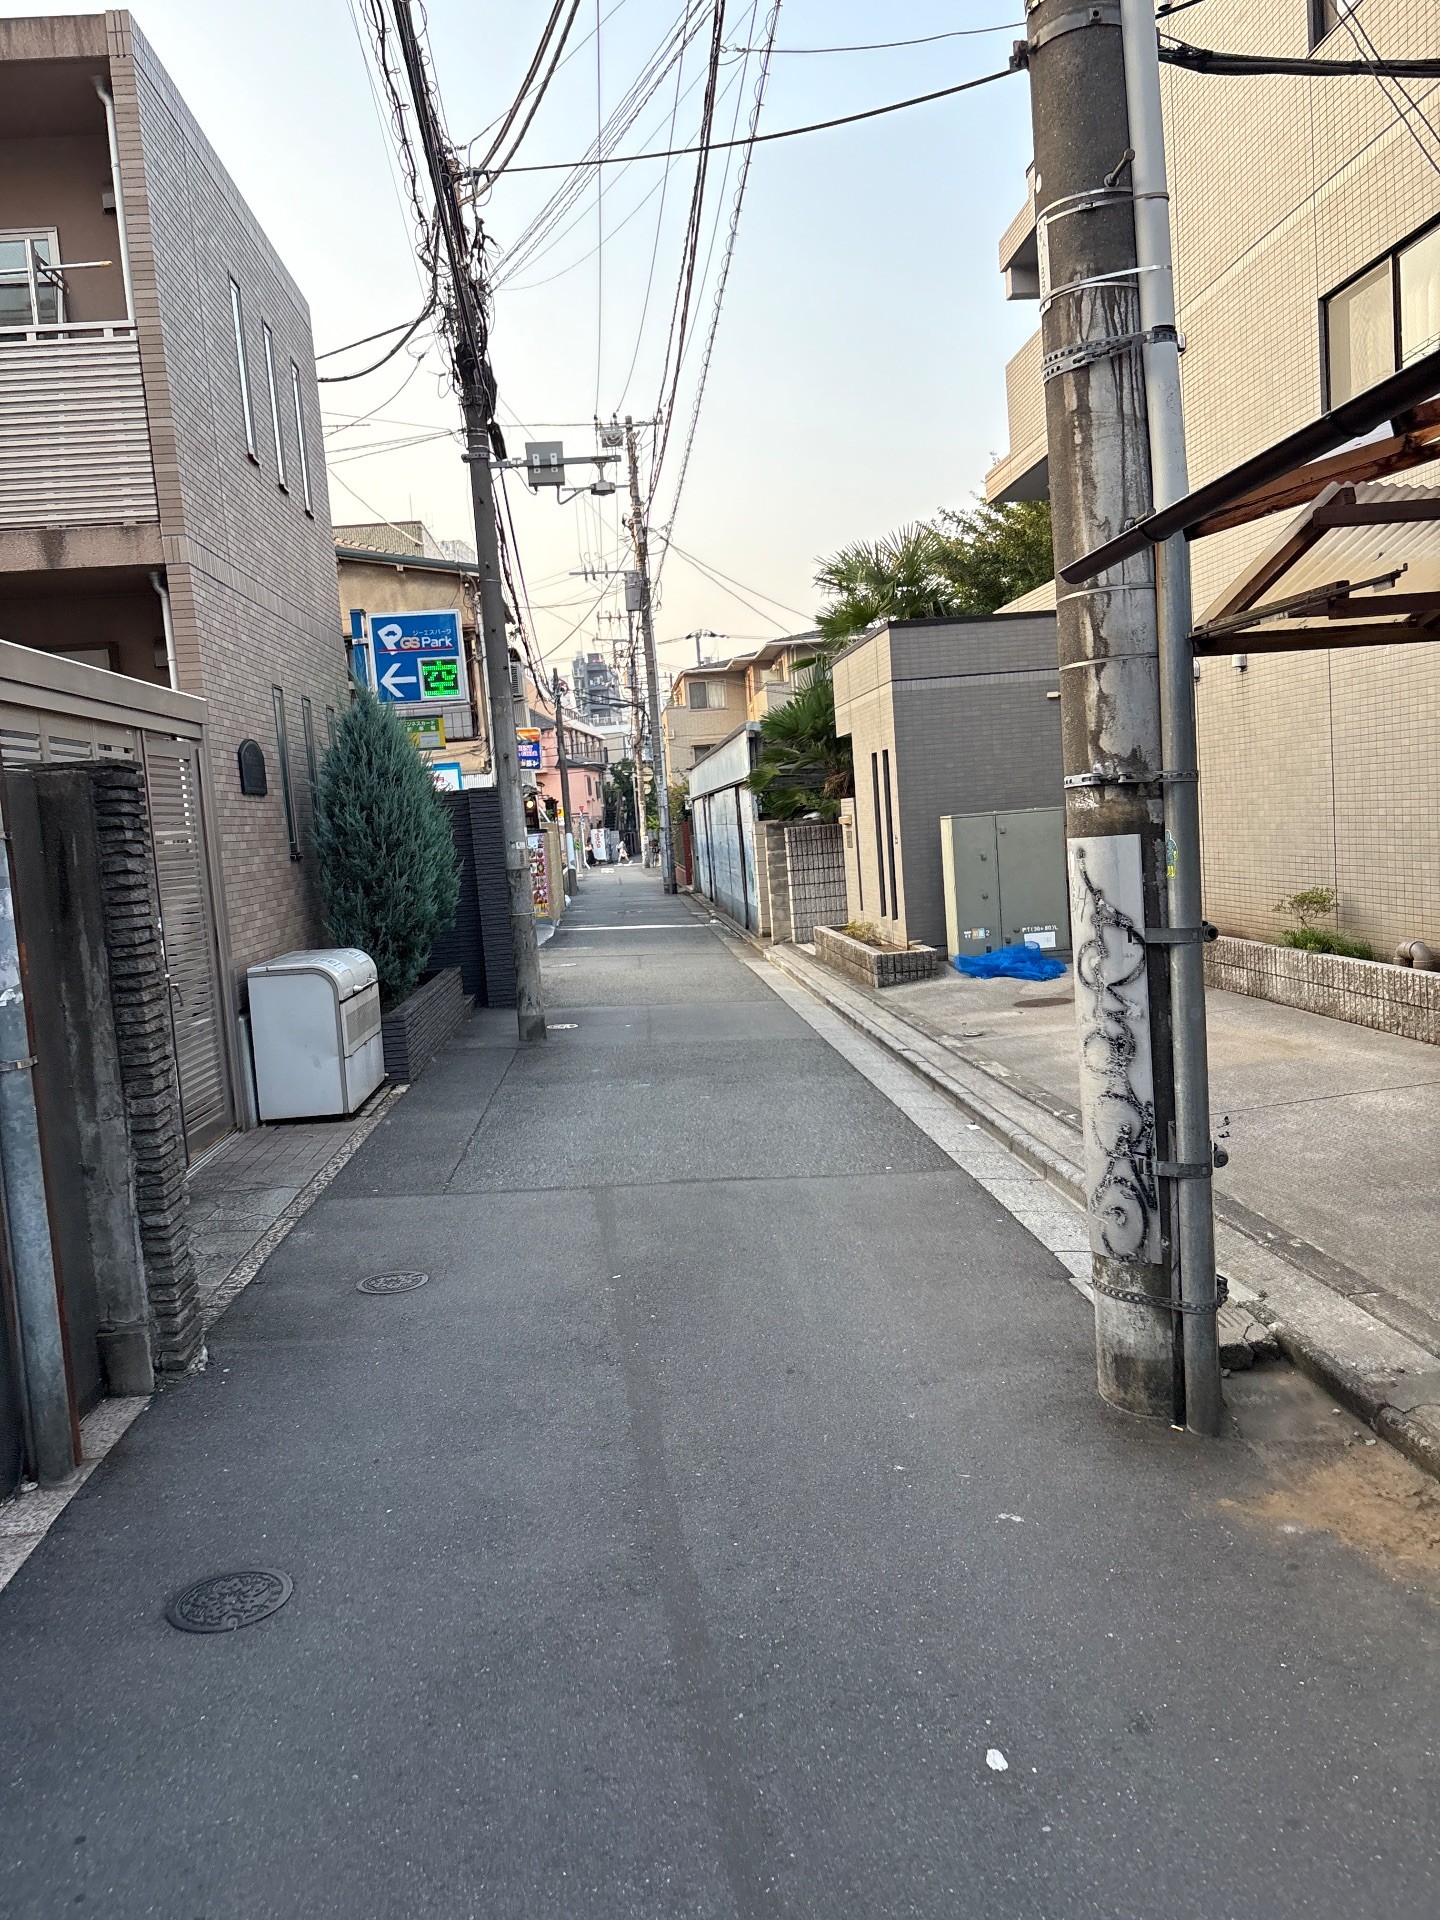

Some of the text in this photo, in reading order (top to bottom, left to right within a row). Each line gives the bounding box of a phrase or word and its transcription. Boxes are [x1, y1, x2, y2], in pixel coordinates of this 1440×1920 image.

[413, 628, 452, 636] ジーエスパーク
[422, 636, 452, 647] Park
[422, 659, 459, 697] 空
